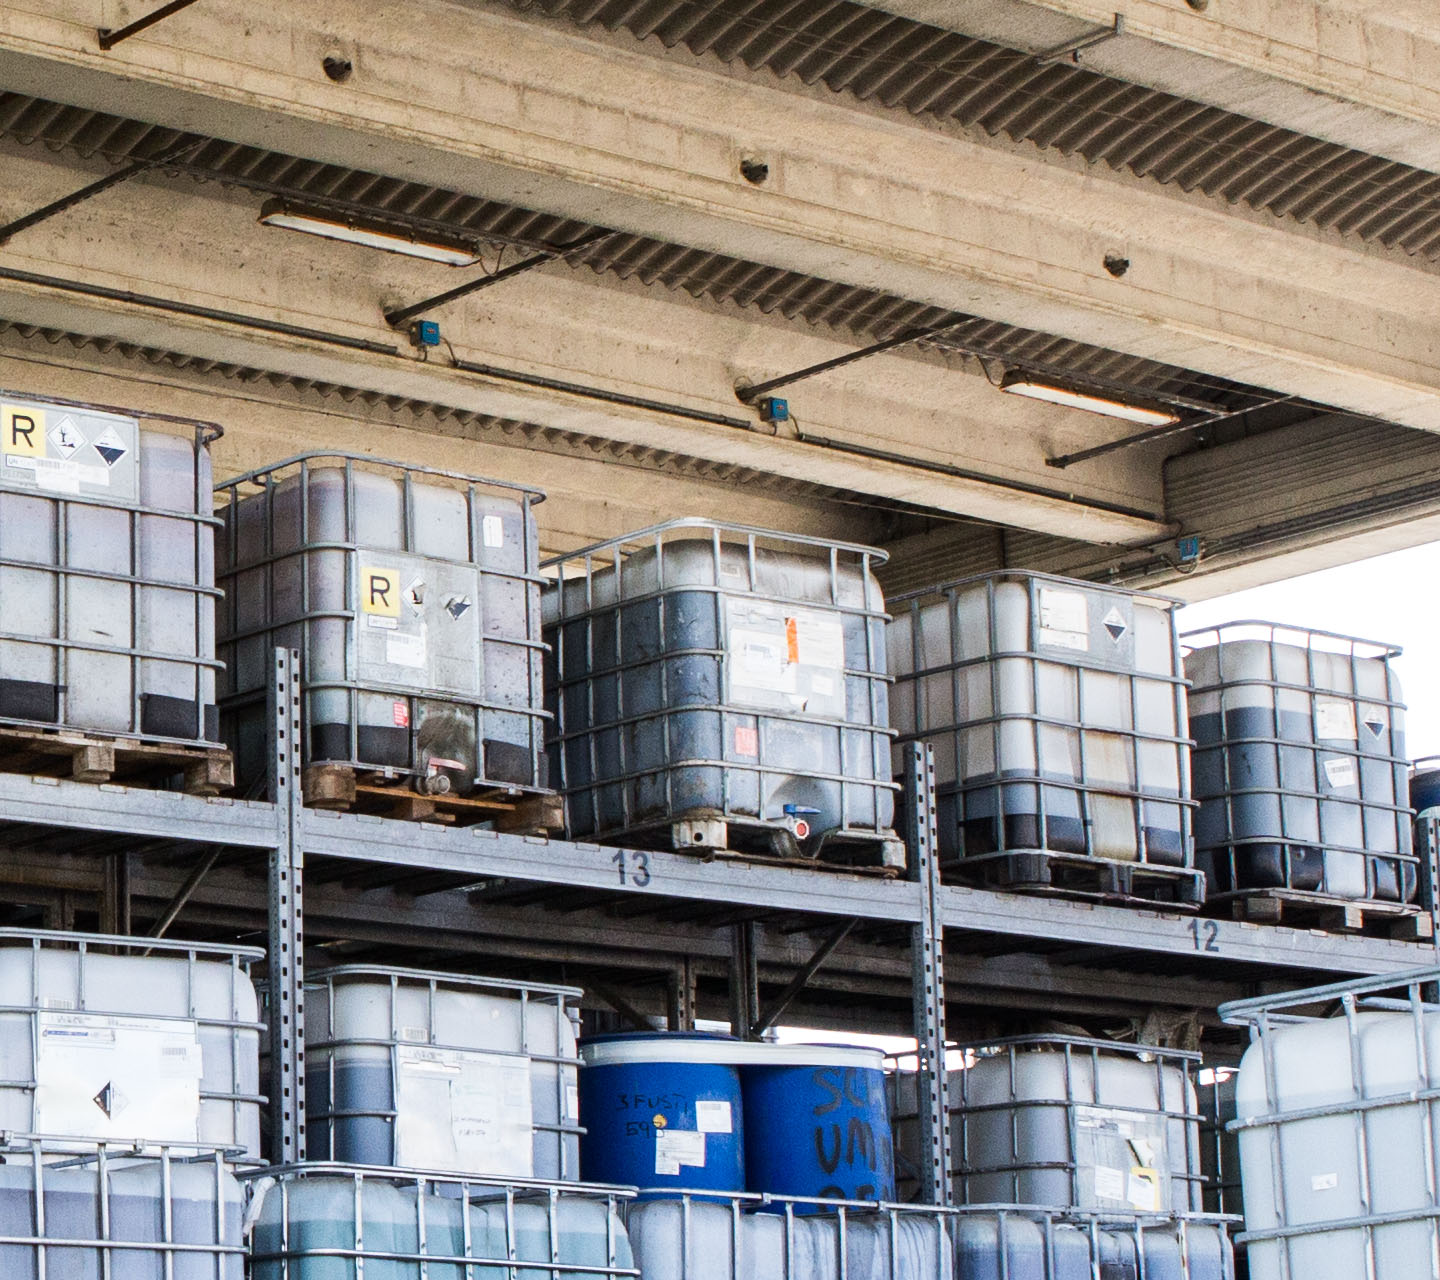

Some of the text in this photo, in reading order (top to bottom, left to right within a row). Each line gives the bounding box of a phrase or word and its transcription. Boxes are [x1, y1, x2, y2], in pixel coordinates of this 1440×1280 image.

[12, 414, 35, 448] R
[370, 575, 391, 607] R
[611, 850, 652, 888] 13
[1187, 918, 1220, 952] 12
